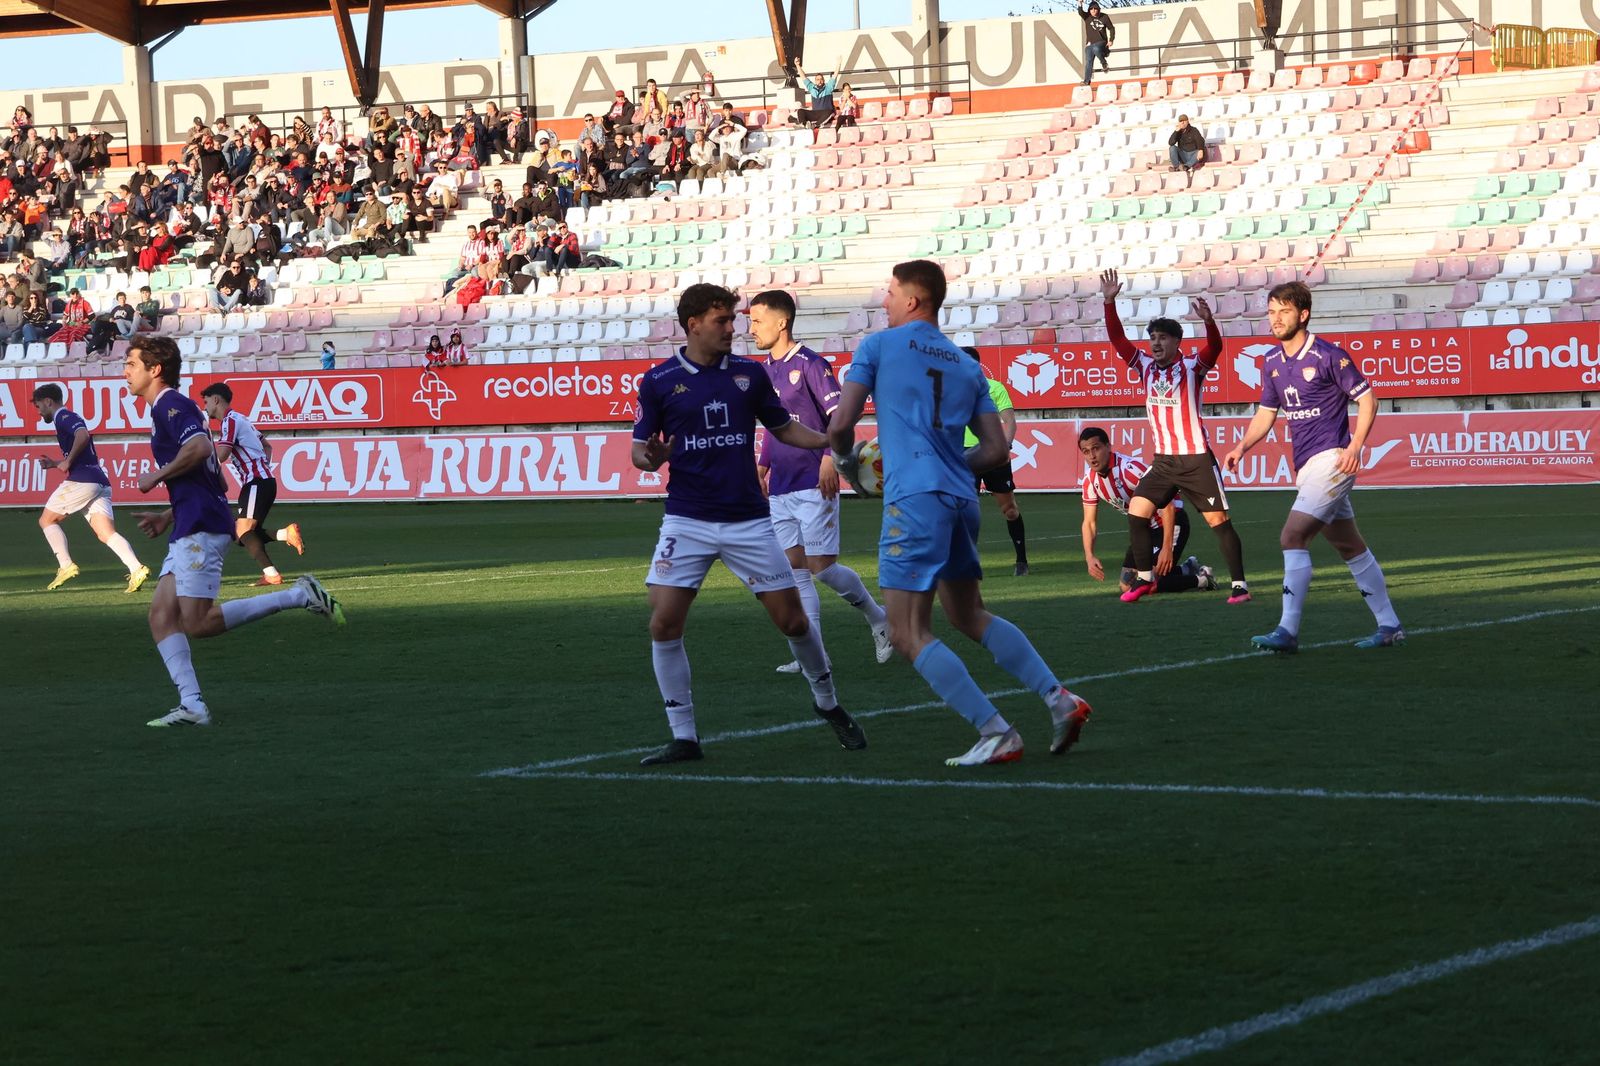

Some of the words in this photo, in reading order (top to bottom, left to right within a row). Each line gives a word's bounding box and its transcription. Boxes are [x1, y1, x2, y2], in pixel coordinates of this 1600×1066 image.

[1361, 354, 1462, 376] cruces
[1489, 354, 1510, 370] la
[484, 366, 613, 398] recoletas
[1060, 365, 1117, 386] tres
[1372, 379, 1410, 387] Benavente
[1415, 378, 1429, 386] 980
[1581, 367, 1600, 385] d
[249, 378, 369, 422] AMAQ
[926, 367, 944, 430] 1
[1061, 389, 1086, 397] Zamora
[260, 413, 324, 422] ALQUILERES
[1285, 408, 1321, 420] ercesa
[1409, 430, 1591, 454] VALDERADUEY
[280, 440, 410, 496] CAJA
[420, 434, 621, 495] RURAL
[1410, 459, 1423, 467] EL
[1425, 459, 1466, 467] CENTRO
[1469, 457, 1529, 466] COMERCIAL
[1532, 457, 1546, 465] DE
[1548, 456, 1594, 465] ZAMORA
[661, 536, 677, 558] 3
